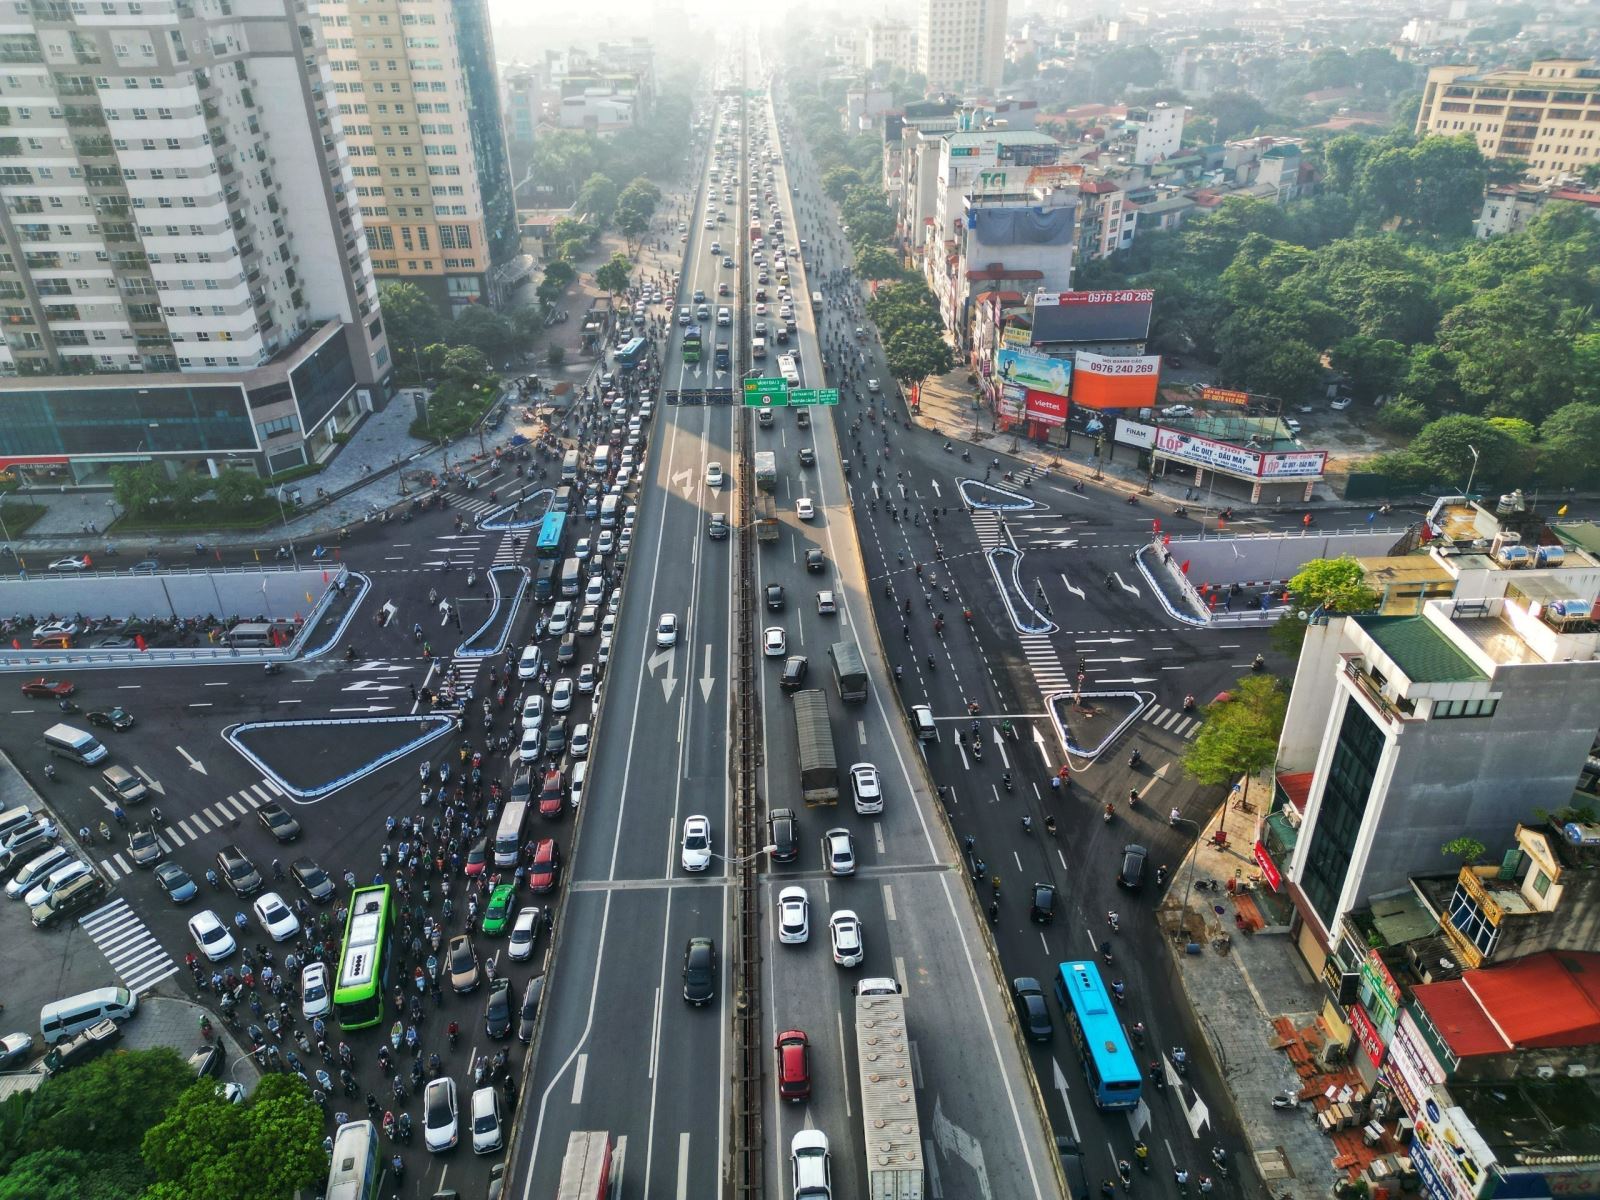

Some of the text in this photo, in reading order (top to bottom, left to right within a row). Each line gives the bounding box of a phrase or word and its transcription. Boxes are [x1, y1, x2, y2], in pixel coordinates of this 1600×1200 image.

[981, 173, 1006, 188] TCI
[1090, 362, 1153, 374] 0976 240 269
[1034, 400, 1060, 410] viettel
